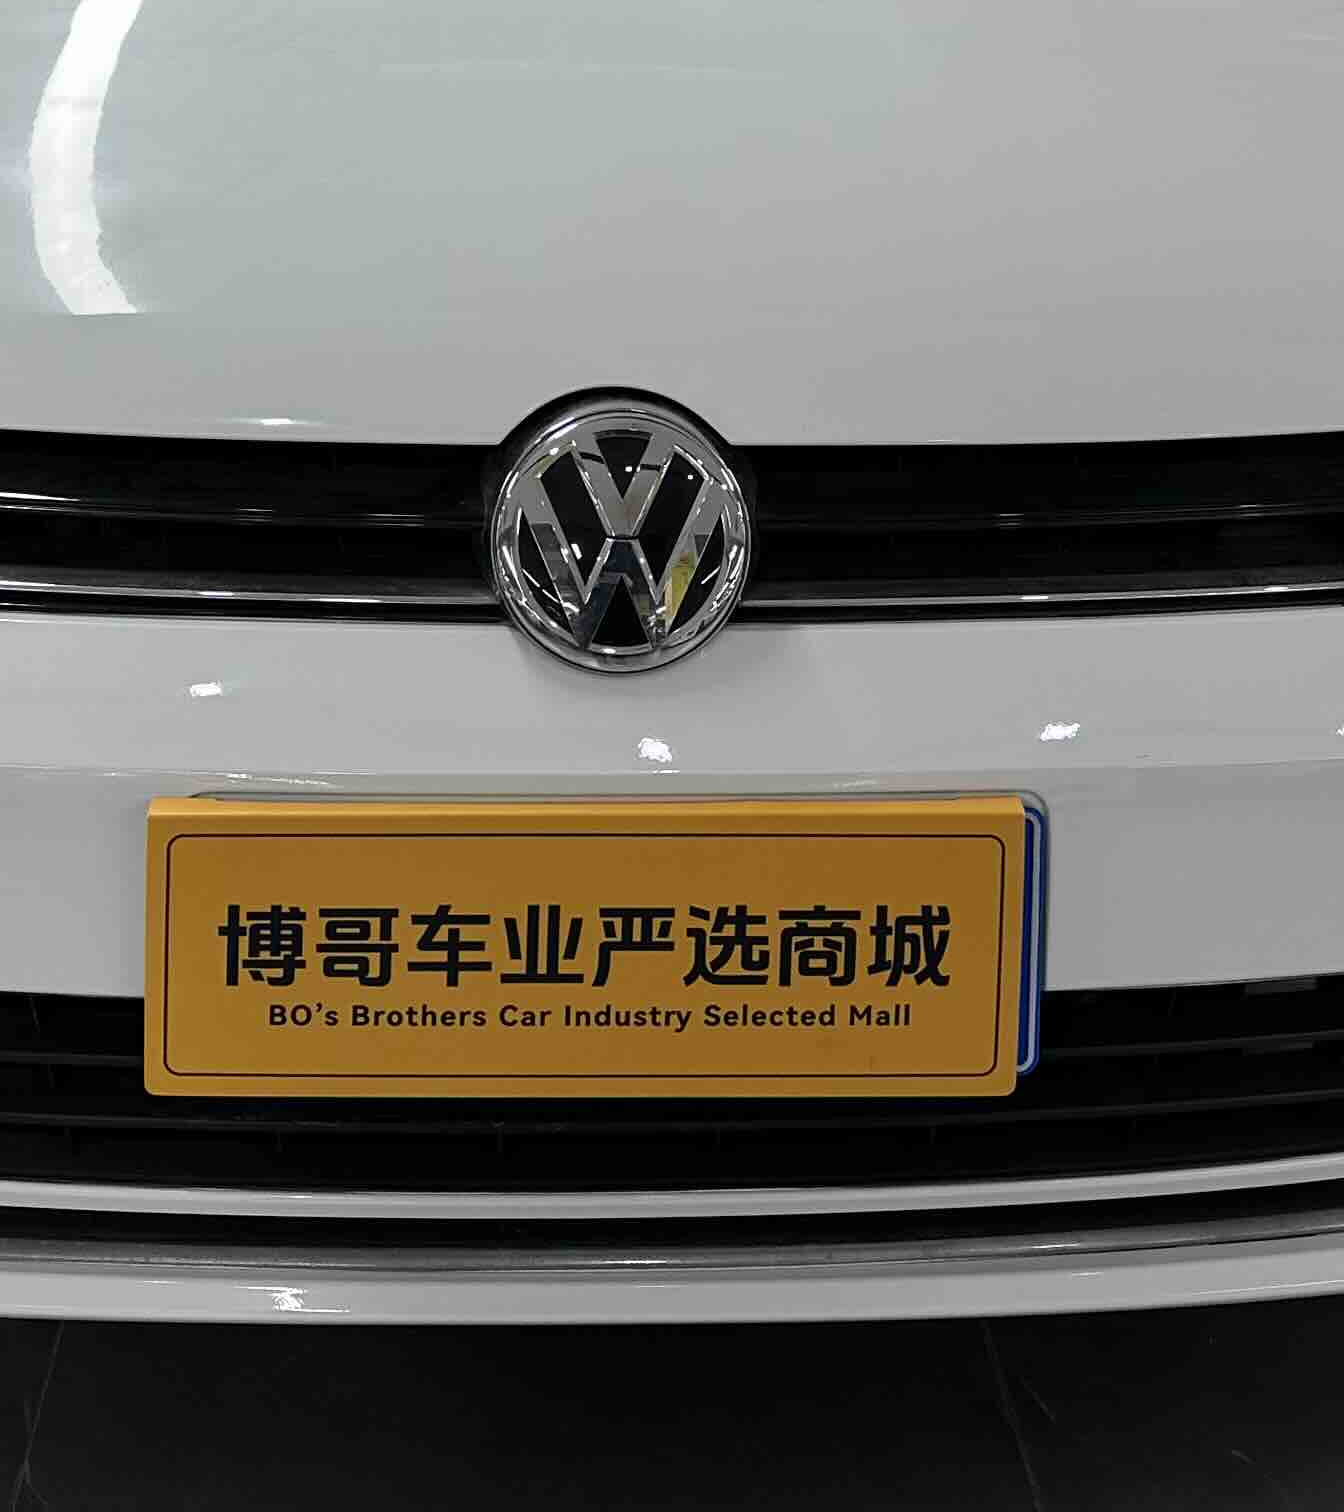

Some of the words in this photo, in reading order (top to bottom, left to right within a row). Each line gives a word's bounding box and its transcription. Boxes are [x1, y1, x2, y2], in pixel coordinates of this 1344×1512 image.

[217, 901, 953, 990] 博哥车业严选商城
[268, 1003, 339, 1027] BO's
[351, 1003, 488, 1028] Brothers
[499, 1003, 552, 1027] Car
[564, 1003, 693, 1033] Industry
[703, 1003, 836, 1028] Selected
[848, 1003, 911, 1028] Mall
